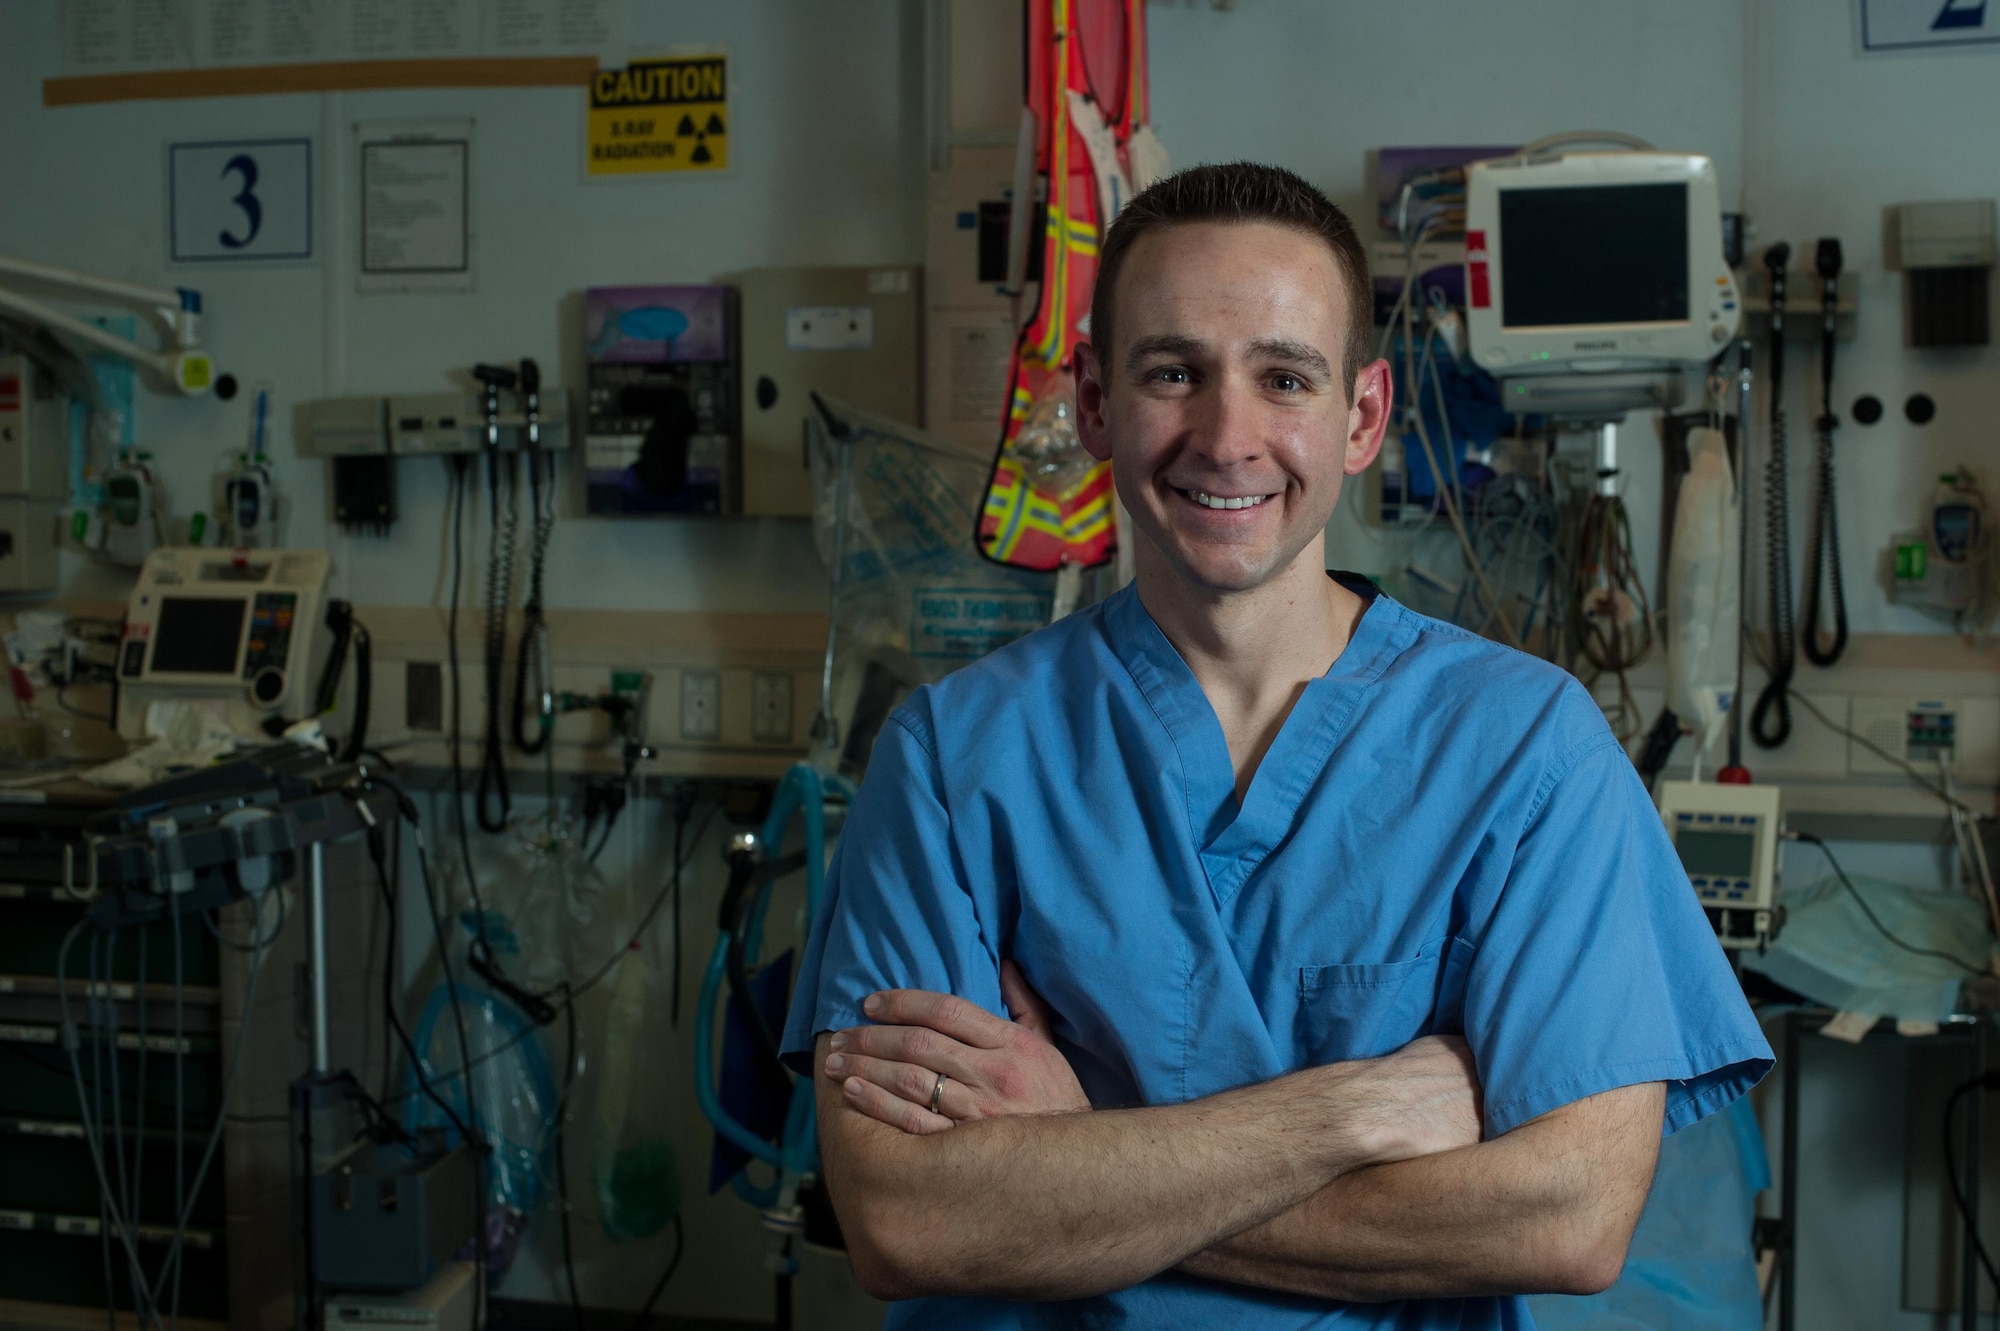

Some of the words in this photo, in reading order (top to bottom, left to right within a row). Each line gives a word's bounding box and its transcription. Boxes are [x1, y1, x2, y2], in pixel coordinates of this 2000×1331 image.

[596, 64, 723, 103] CAUTION
[594, 141, 676, 160] RADIATION
[219, 154, 262, 250] 3
